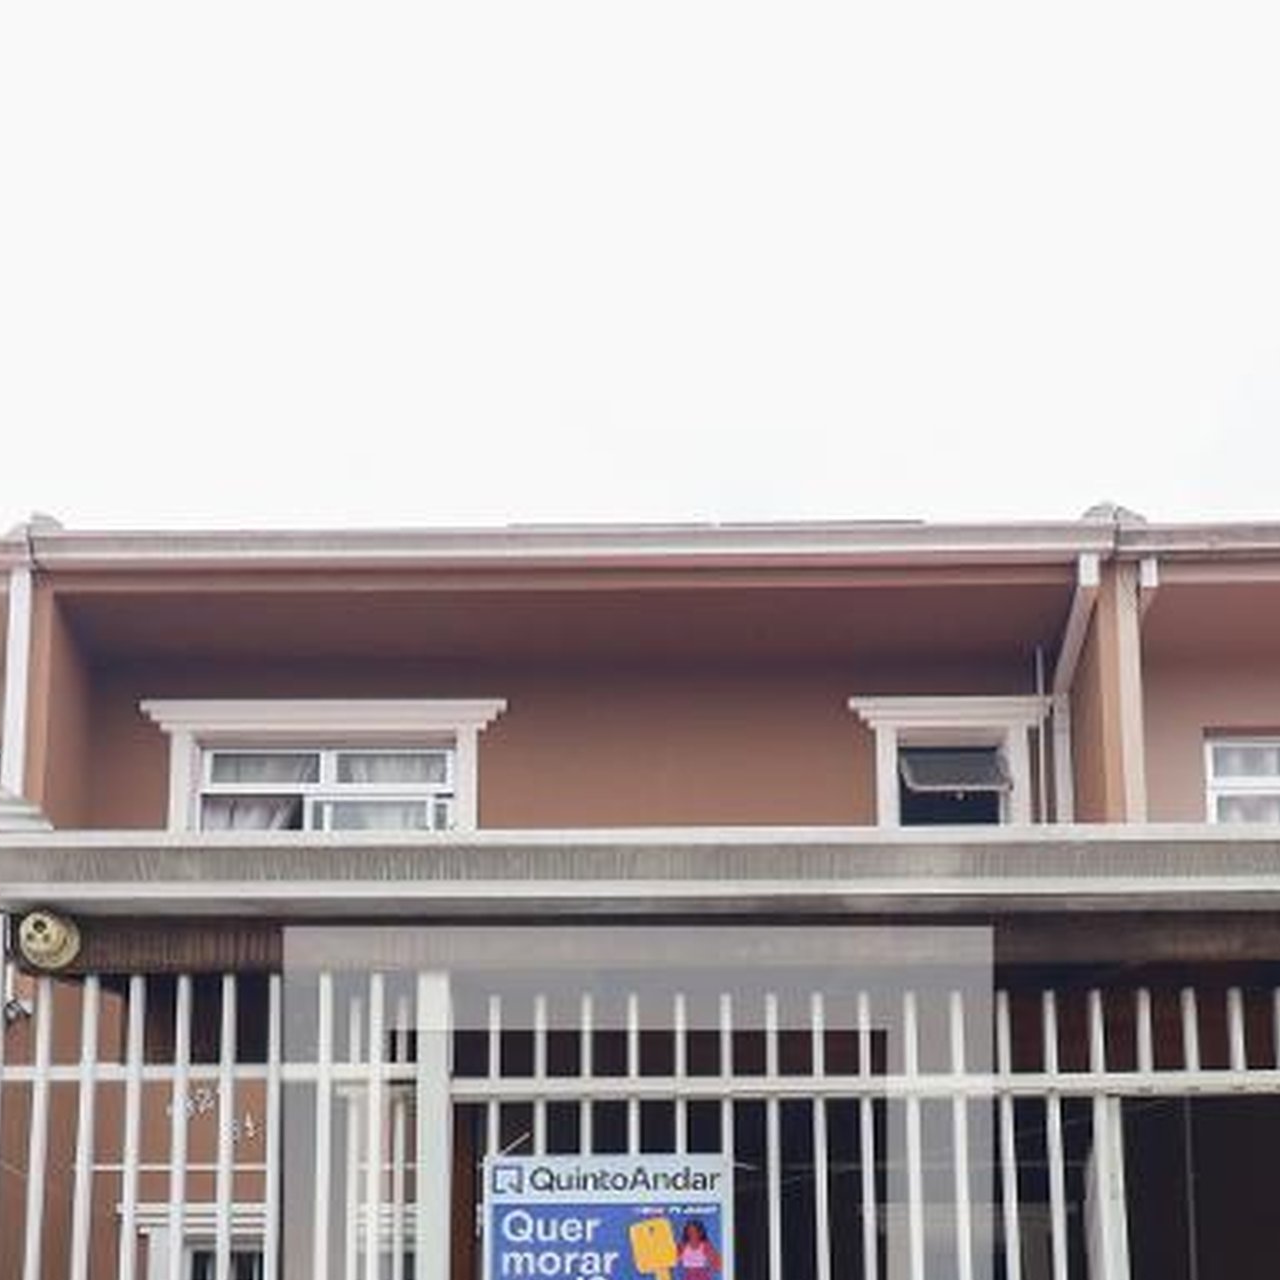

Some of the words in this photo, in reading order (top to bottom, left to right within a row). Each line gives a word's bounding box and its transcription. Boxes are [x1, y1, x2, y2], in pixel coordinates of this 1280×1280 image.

[529, 1166, 720, 1192] QuintoAndar
[502, 1209, 601, 1243] Quer
[502, 1251, 619, 1276] morar
